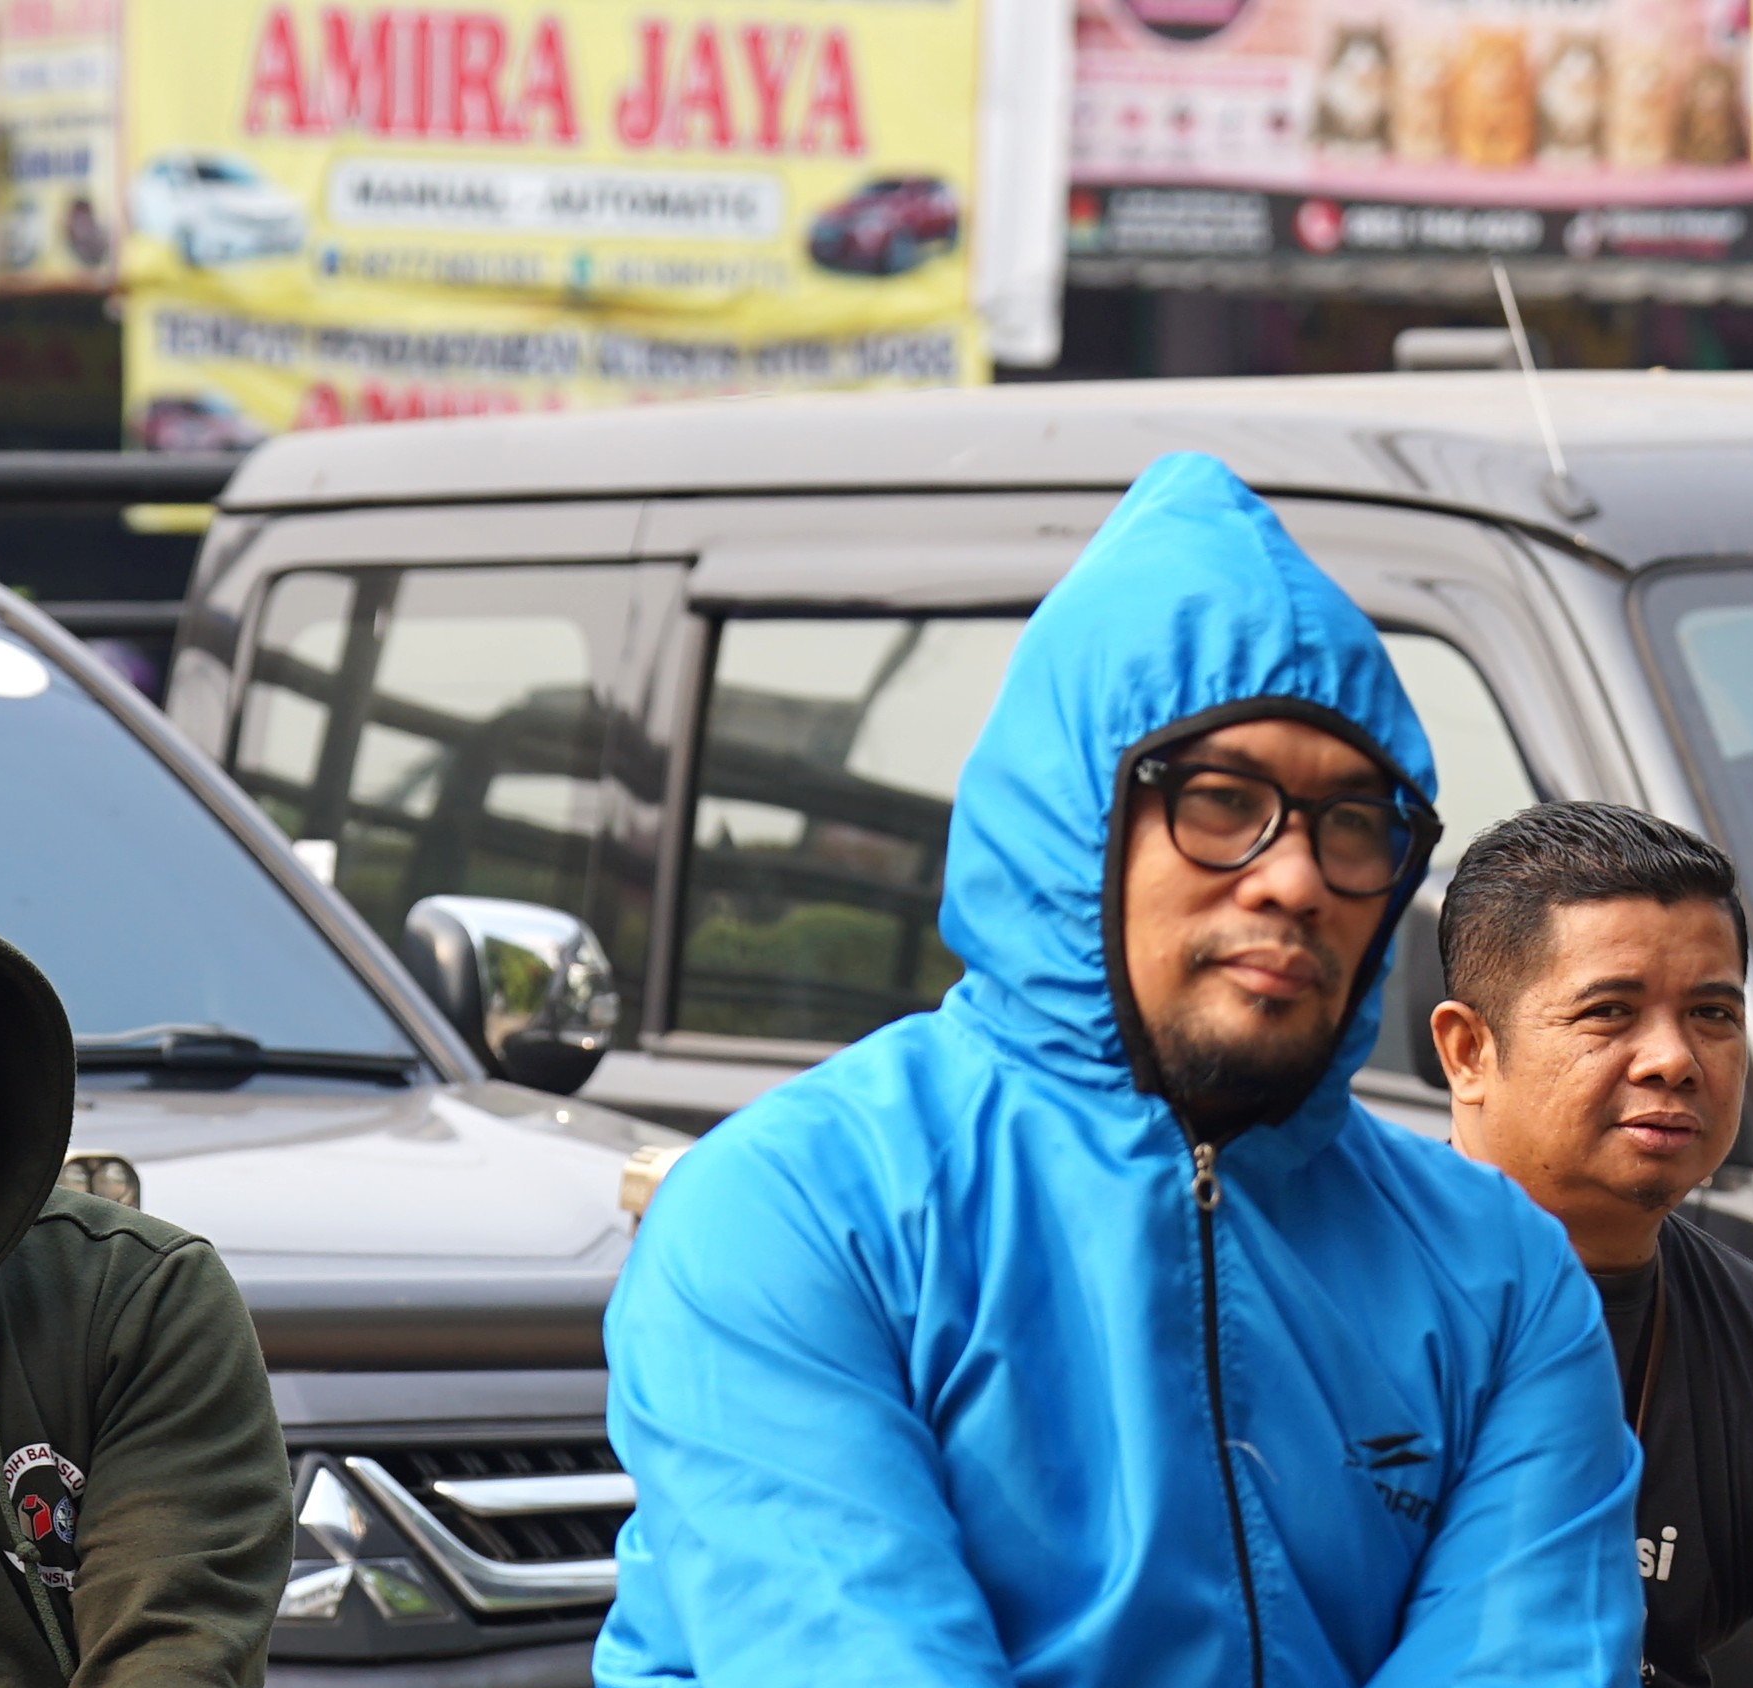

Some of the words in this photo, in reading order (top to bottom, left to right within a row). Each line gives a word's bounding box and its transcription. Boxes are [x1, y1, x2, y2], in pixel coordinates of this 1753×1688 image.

[244, 6, 582, 145] AMIRA
[613, 20, 868, 158] JAYA
[27, 1447, 85, 1491] BASLU
